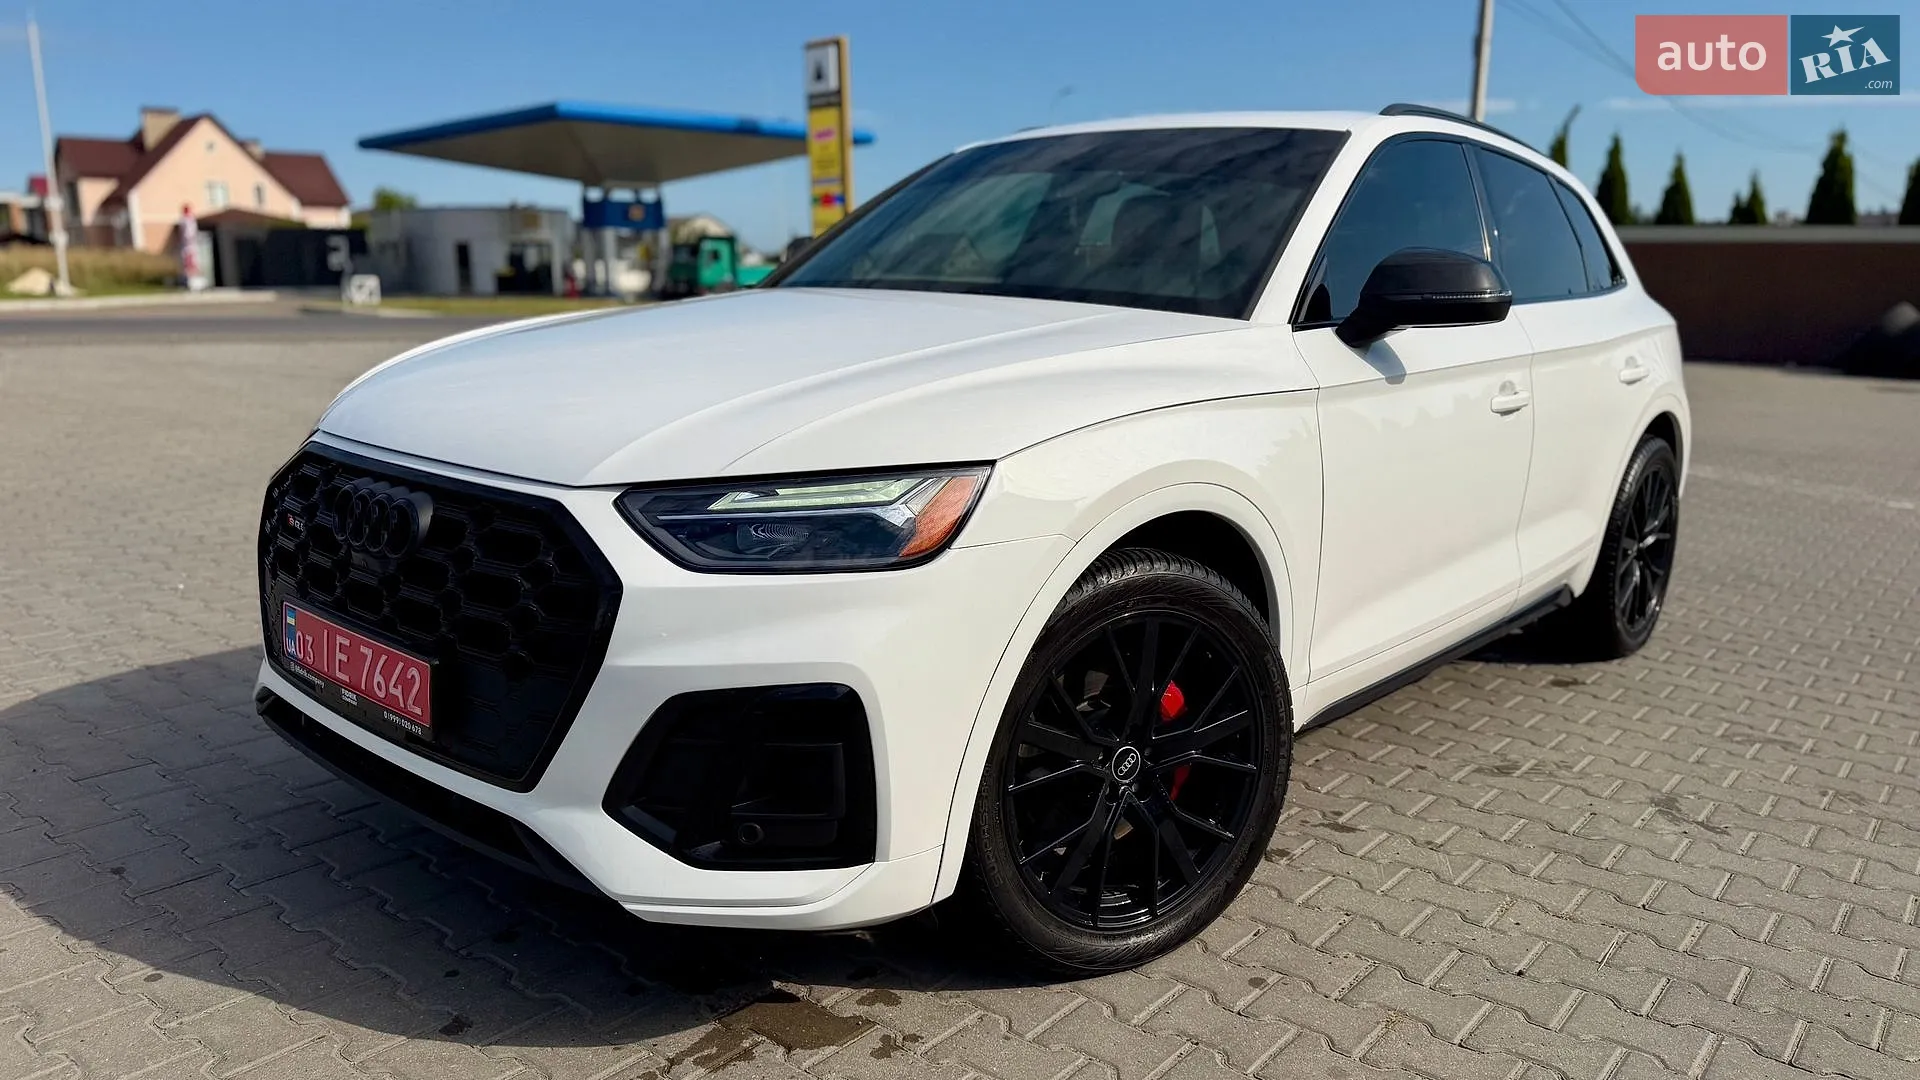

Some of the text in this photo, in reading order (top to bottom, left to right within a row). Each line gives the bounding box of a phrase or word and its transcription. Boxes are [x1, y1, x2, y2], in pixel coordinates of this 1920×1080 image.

[286, 637, 297, 658] UA
[296, 629, 423, 716] 03 IE 7642
